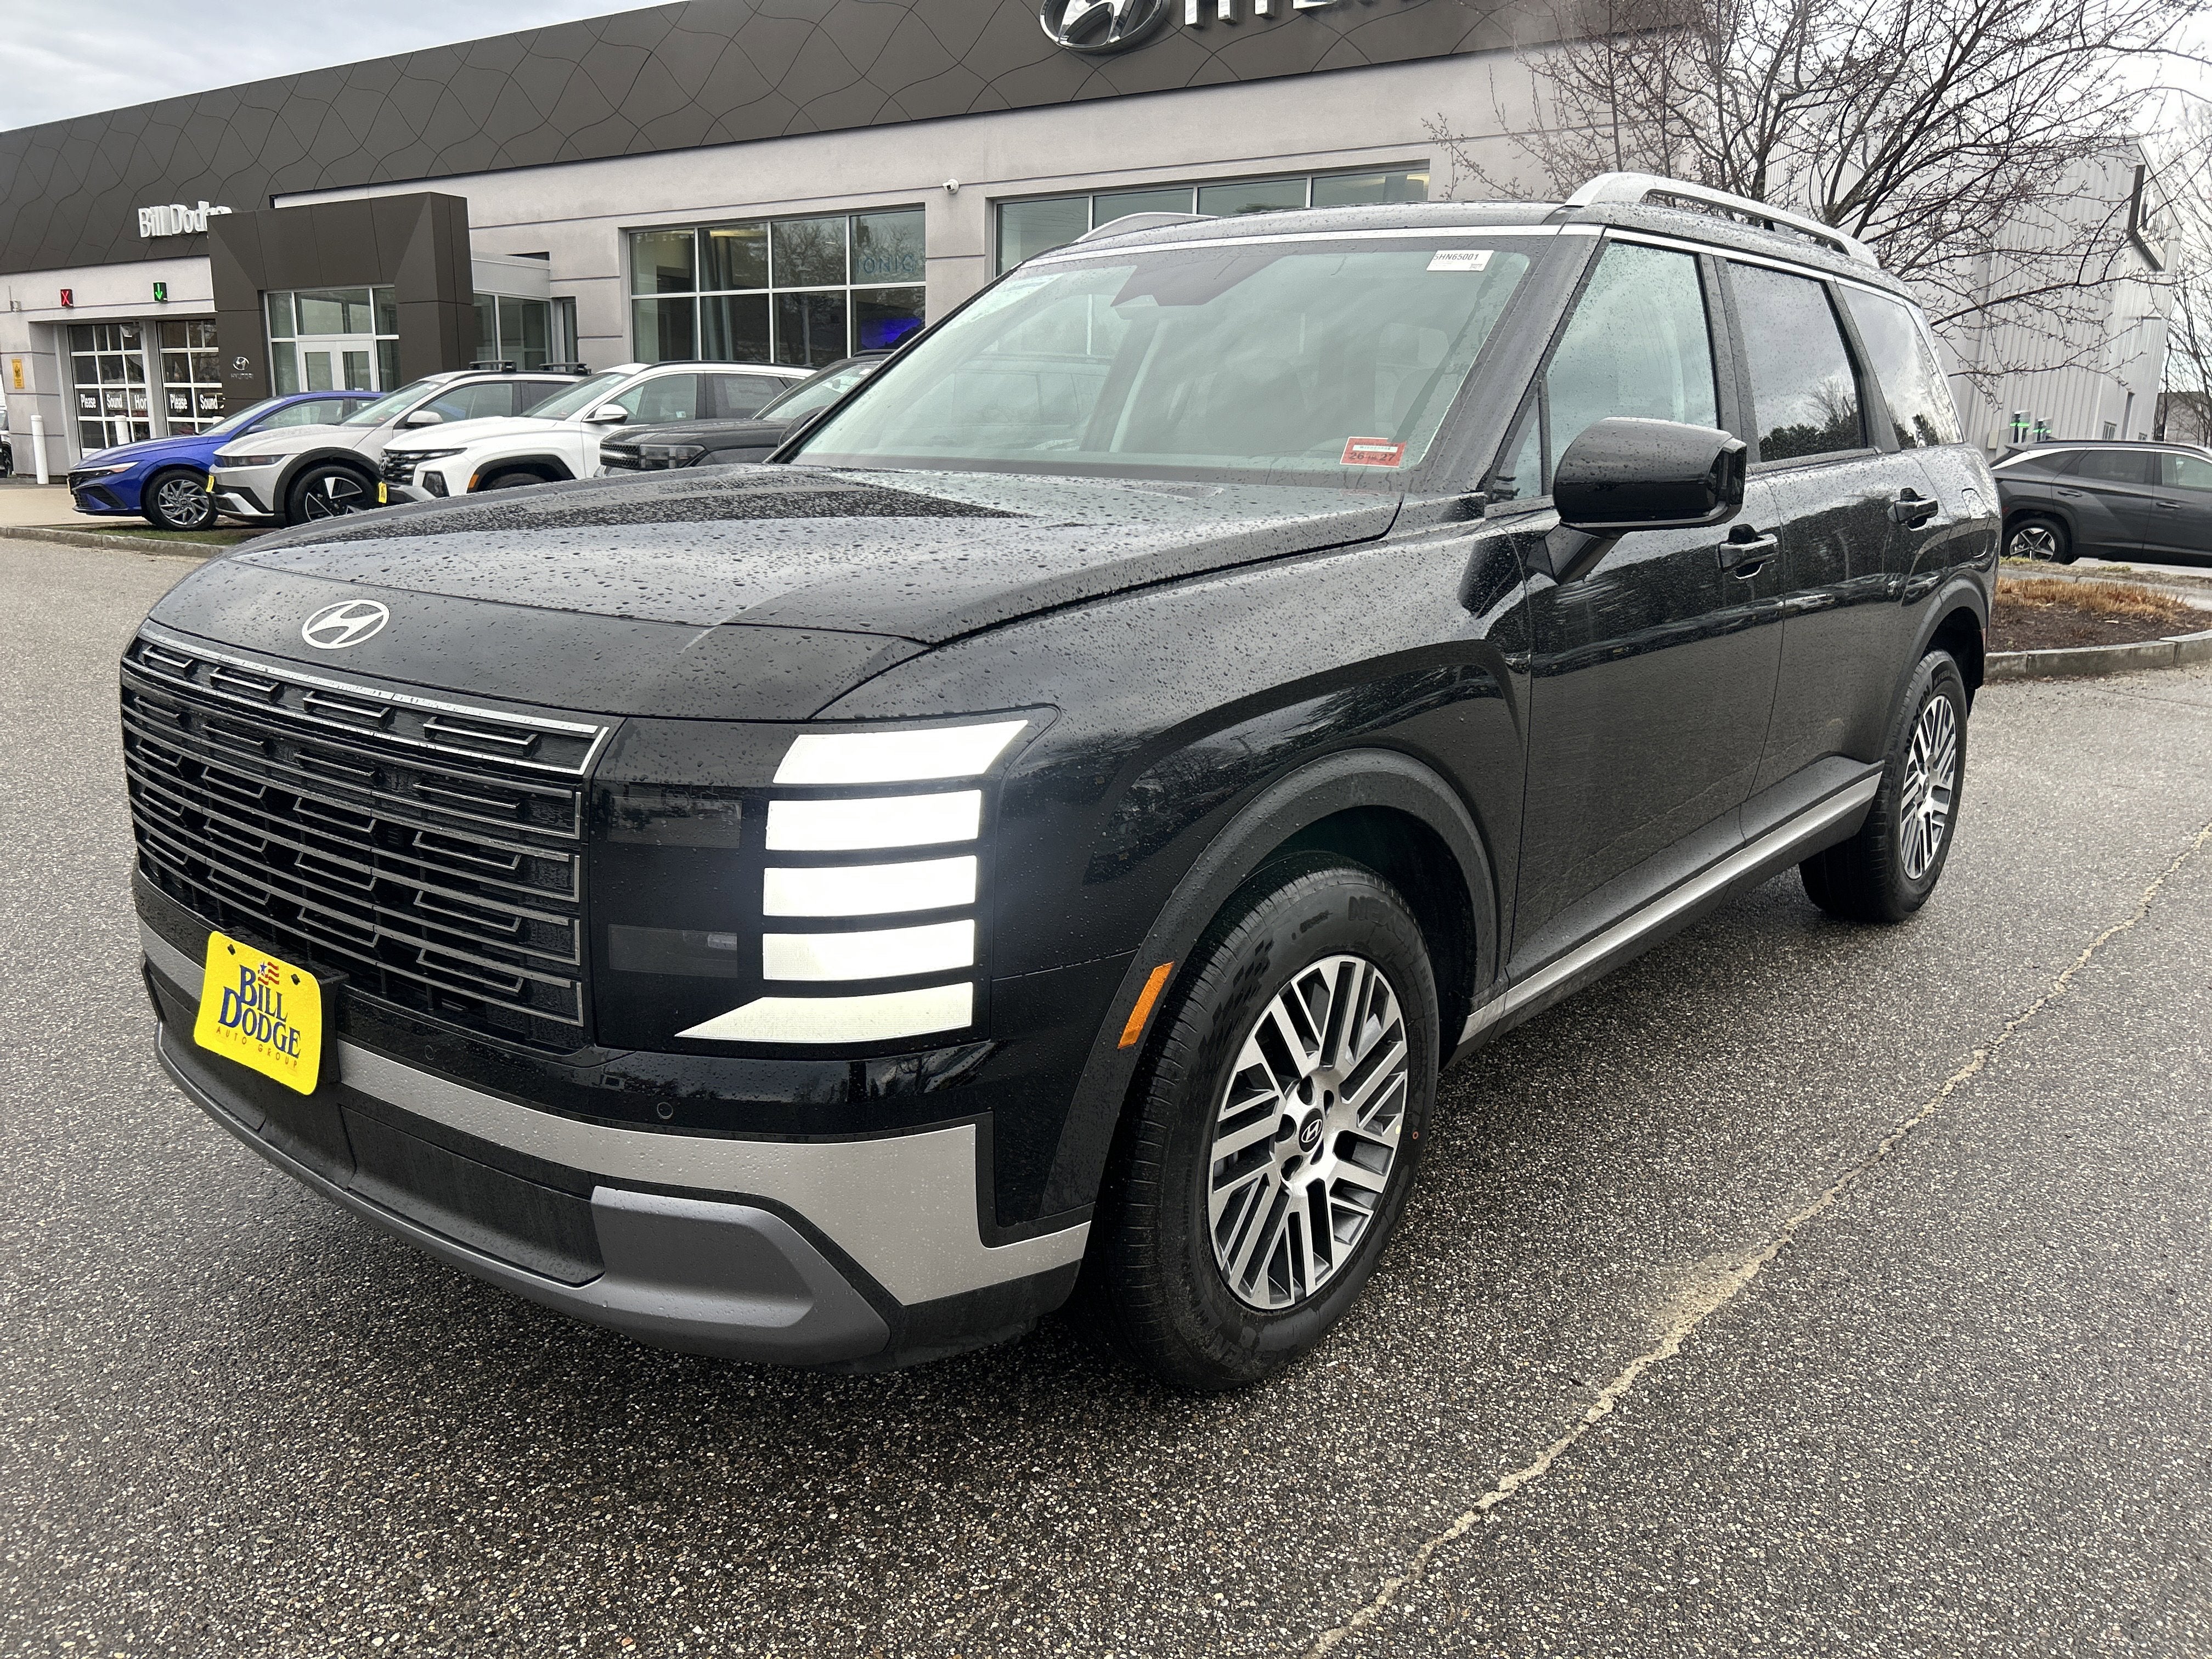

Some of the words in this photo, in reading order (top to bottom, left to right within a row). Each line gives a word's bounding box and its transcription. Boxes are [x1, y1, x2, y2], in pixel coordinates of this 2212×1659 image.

[138, 205, 172, 238] Bill
[170, 200, 233, 235] Dod
[80, 394, 97, 409] Please
[106, 394, 123, 409] Sound
[134, 394, 147, 410] Hor
[170, 393, 188, 410] Please
[200, 394, 218, 410] Sound
[1379, 453, 1396, 461] 27
[239, 964, 288, 1023] BILL
[217, 985, 301, 1059] DODGE
[216, 1026, 247, 1045] AUTO
[258, 1043, 297, 1068] GROUP
